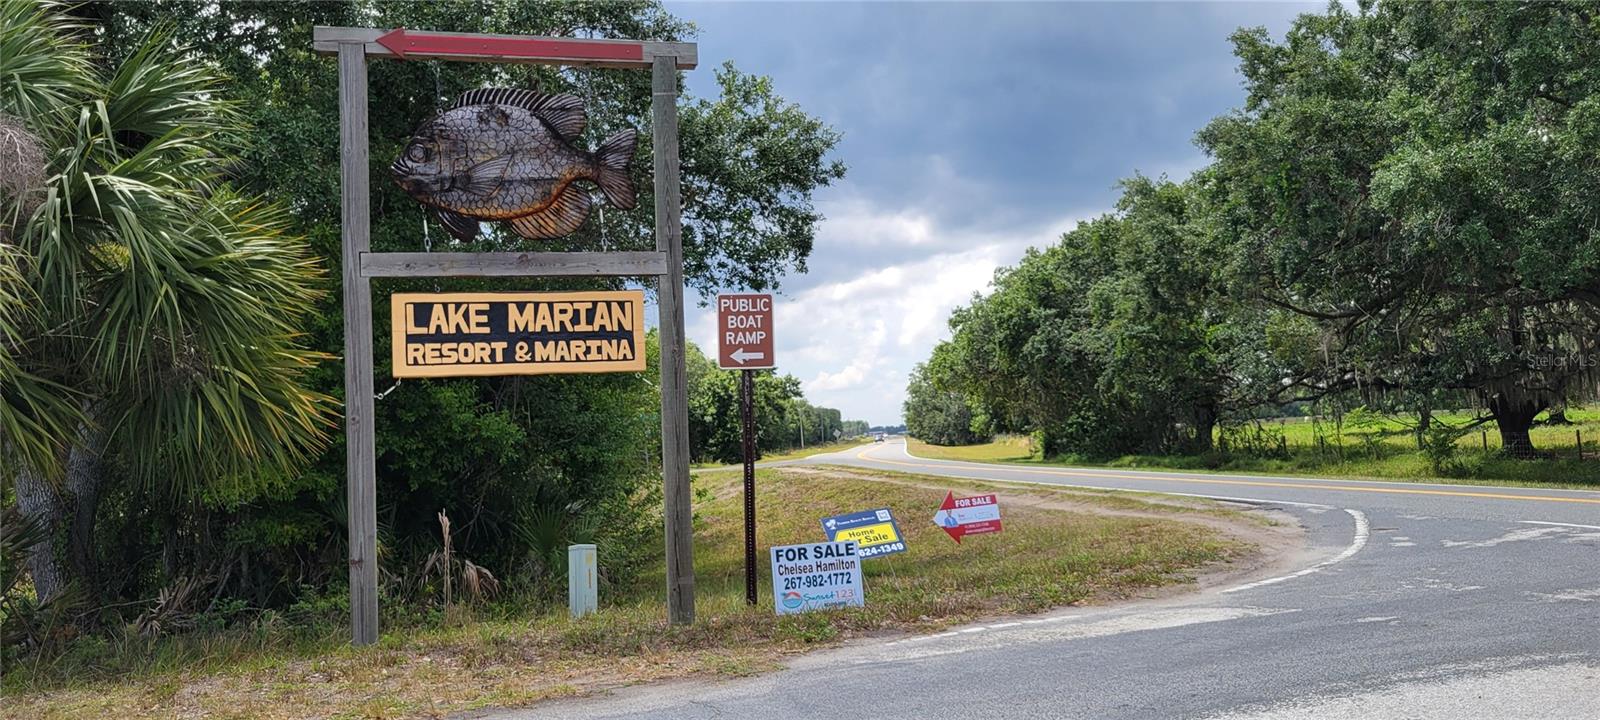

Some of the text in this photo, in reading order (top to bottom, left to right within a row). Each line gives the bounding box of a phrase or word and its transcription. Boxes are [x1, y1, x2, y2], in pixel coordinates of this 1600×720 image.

[721, 299, 769, 312] PUBLIC
[406, 302, 632, 334] LAKE MARIAN
[728, 315, 763, 328] BOAT
[726, 331, 766, 344] RAMP
[407, 339, 633, 365] RESORT & MARINA
[955, 496, 992, 507] FOR SALE
[848, 528, 875, 539] Home
[864, 533, 888, 543] Sale
[775, 543, 855, 562] FOR SALE
[778, 559, 856, 576] Chelsea Hamilton
[784, 572, 852, 590] 267-982-1772
